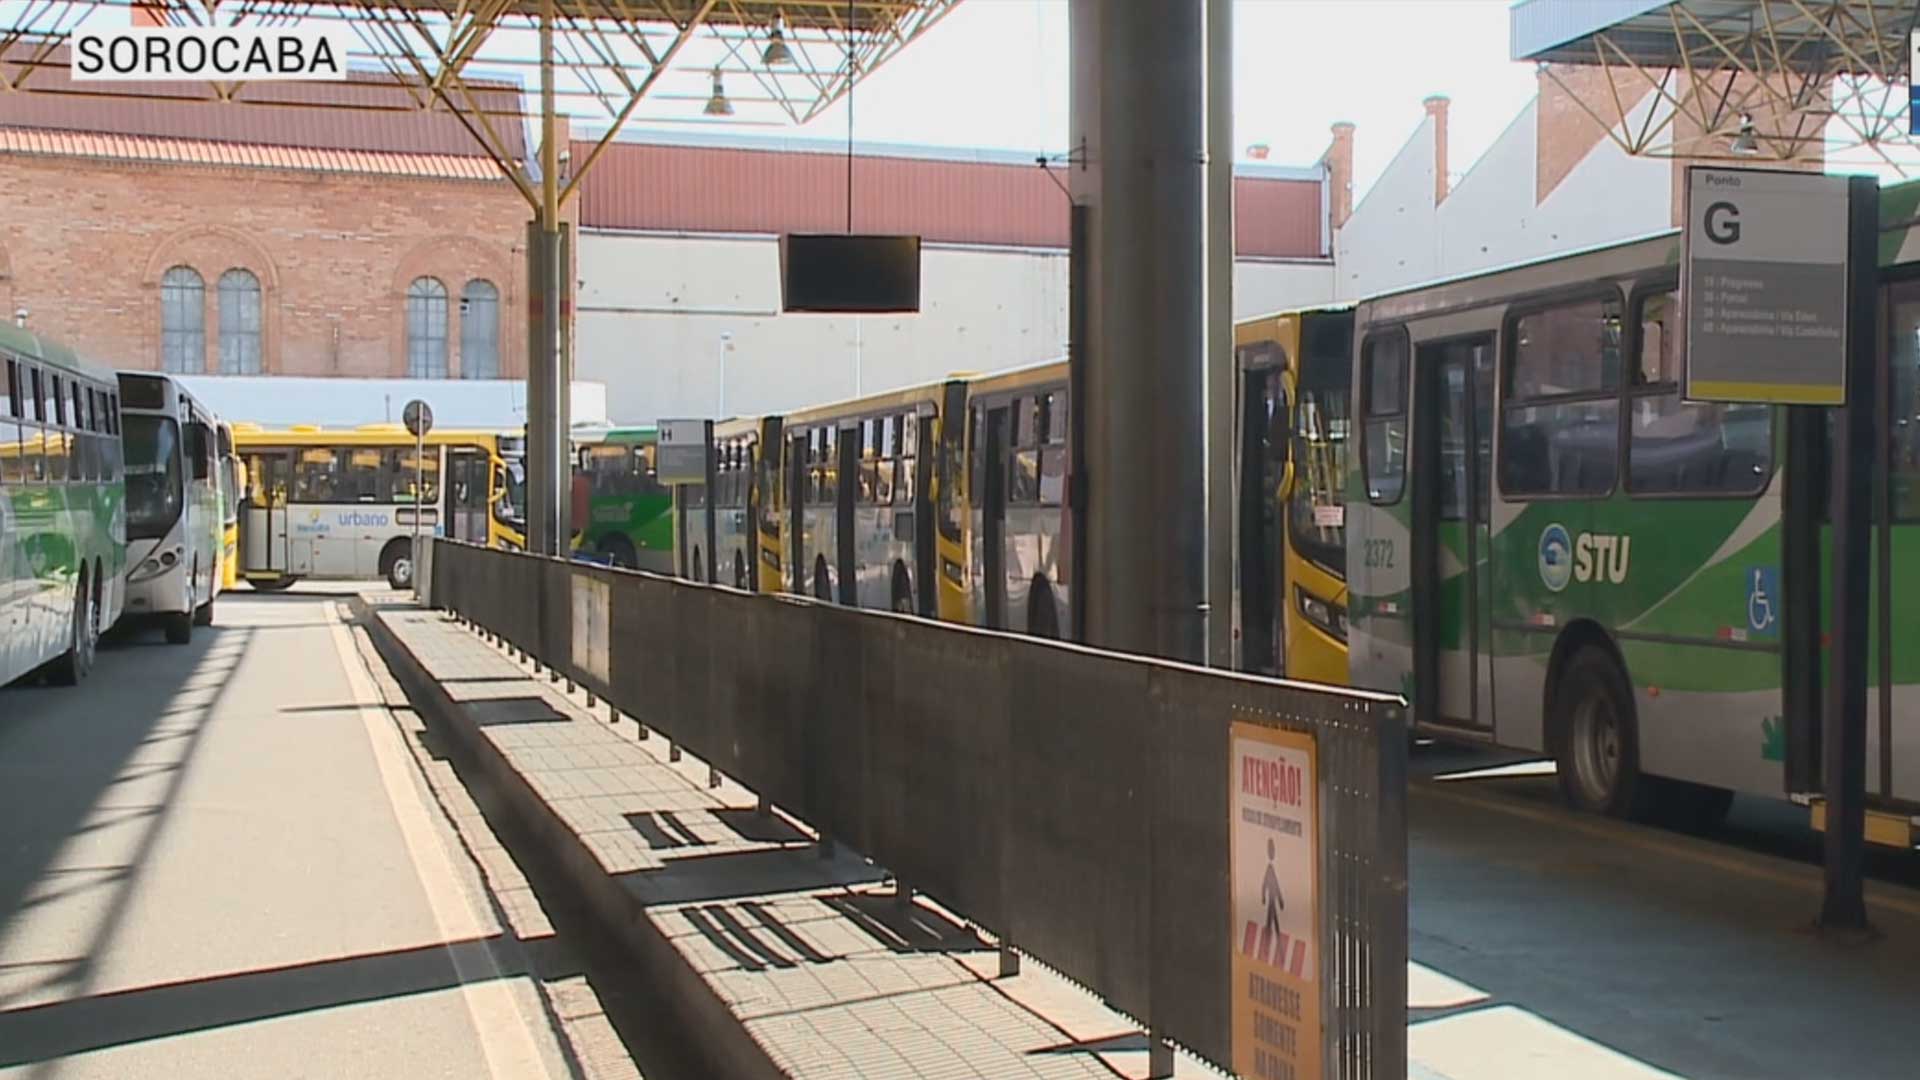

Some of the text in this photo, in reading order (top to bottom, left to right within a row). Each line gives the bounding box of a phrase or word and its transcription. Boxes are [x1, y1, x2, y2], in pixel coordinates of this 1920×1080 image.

[1705, 174, 1742, 187] Ponto
[1703, 201, 1741, 244] G
[661, 429, 672, 440] H
[338, 510, 389, 527] urbano
[1364, 538, 1394, 568] 2372
[1574, 532, 1630, 584] STU
[1242, 755, 1302, 808] ATENÇÃO!
